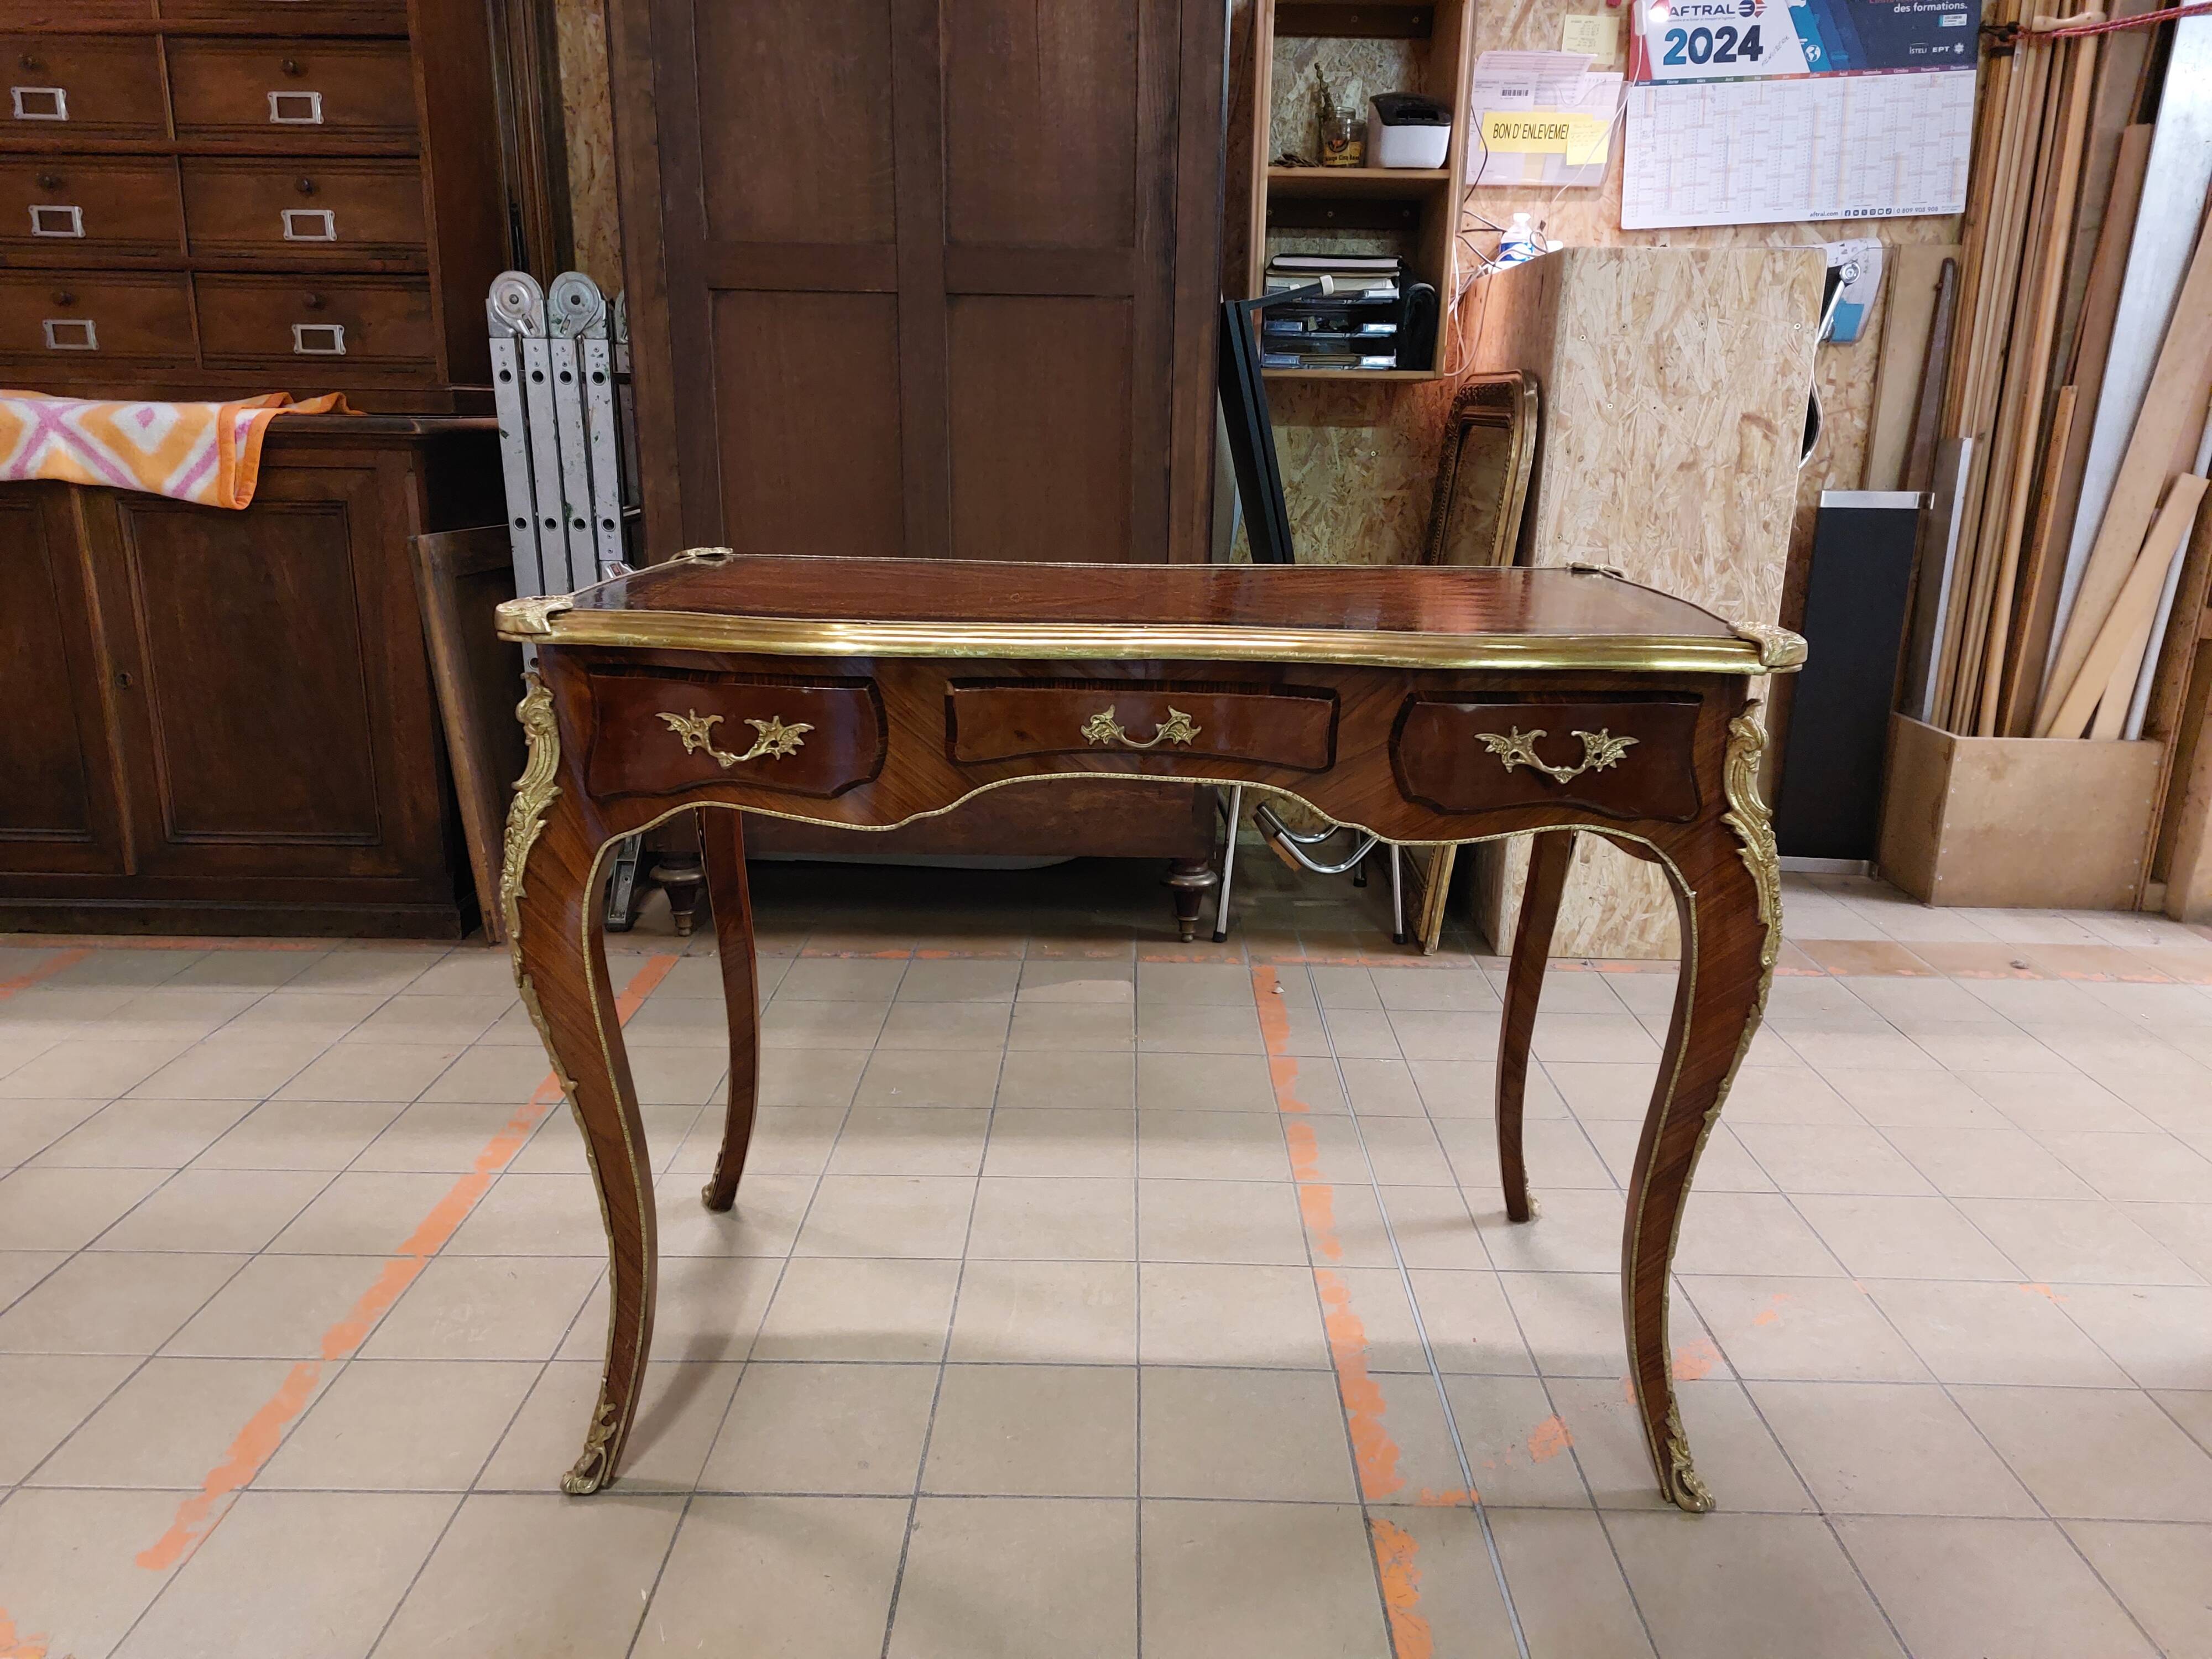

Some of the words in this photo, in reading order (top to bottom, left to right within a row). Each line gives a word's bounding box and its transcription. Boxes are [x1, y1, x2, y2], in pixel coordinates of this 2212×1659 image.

[1670, 4, 1735, 17] AFTRAL
[1893, 3, 1911, 13] des
[1913, 1, 1968, 12] formations.
[1663, 25, 1764, 65] 2024
[1493, 123, 1511, 139] BON
[1522, 123, 1569, 139] ENLEVEME
